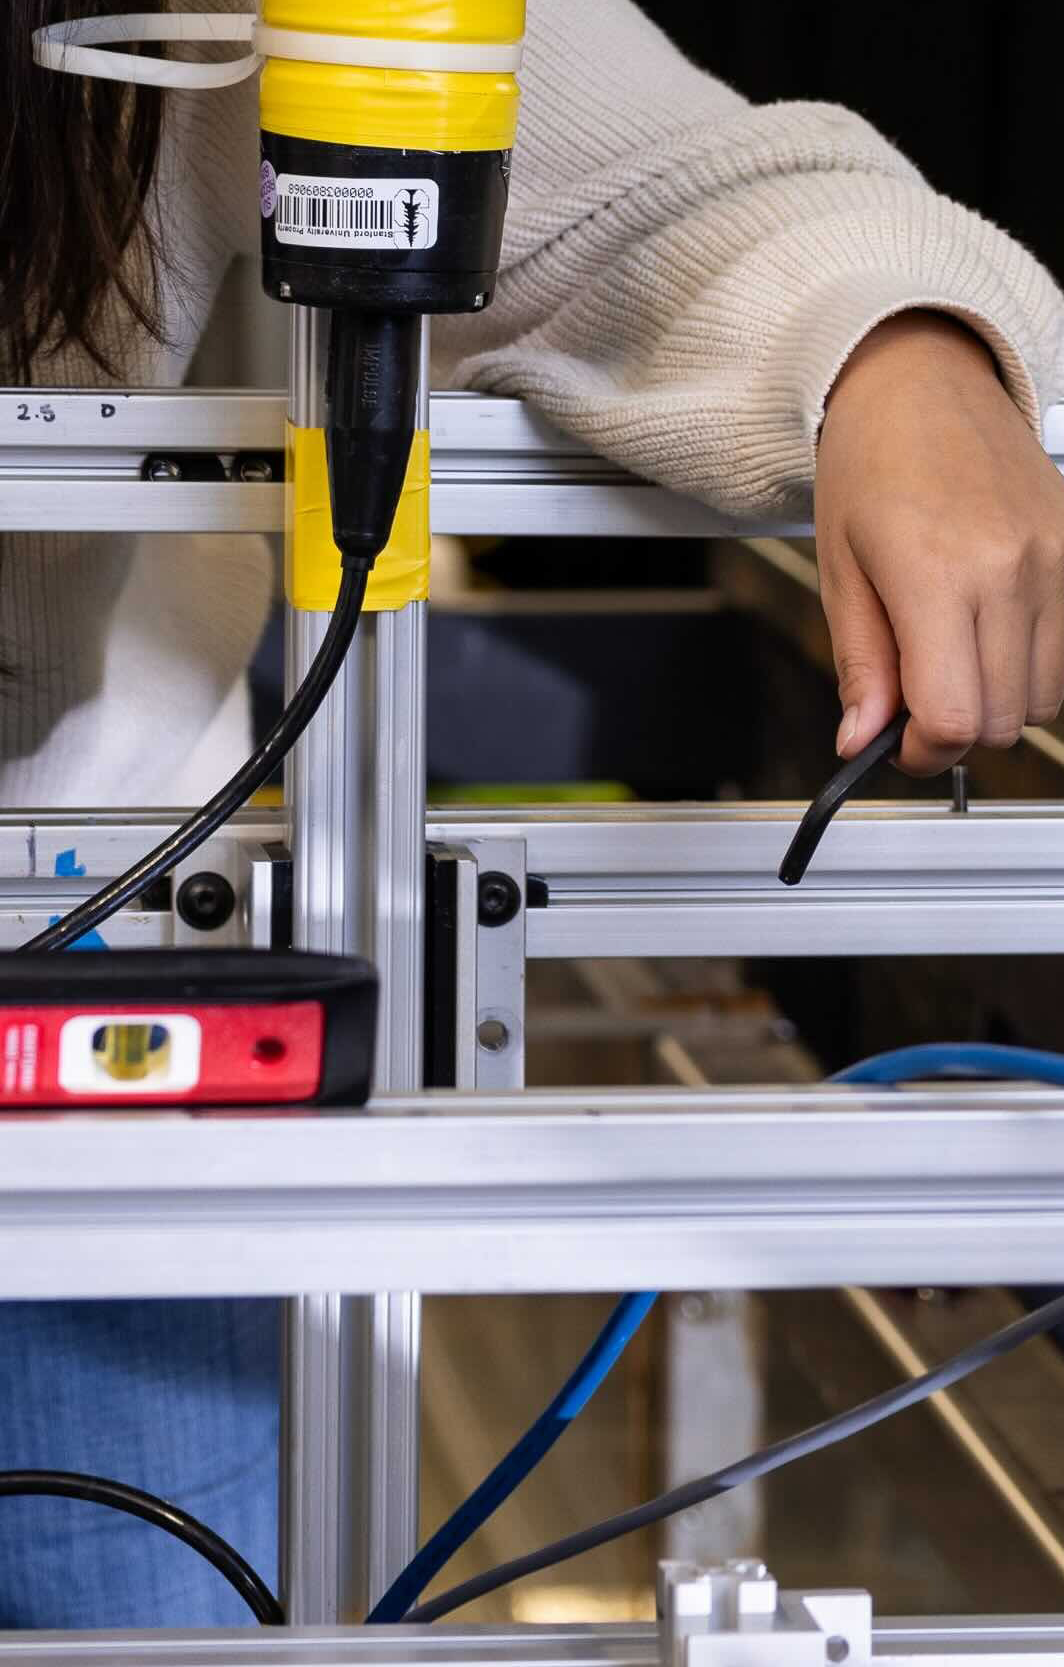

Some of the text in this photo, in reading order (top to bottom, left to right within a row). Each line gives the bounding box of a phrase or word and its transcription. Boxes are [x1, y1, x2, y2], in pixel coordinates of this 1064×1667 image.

[288, 183, 374, 199] 000003809068
[354, 230, 394, 239] Stanford
[17, 403, 56, 422] 2.5
